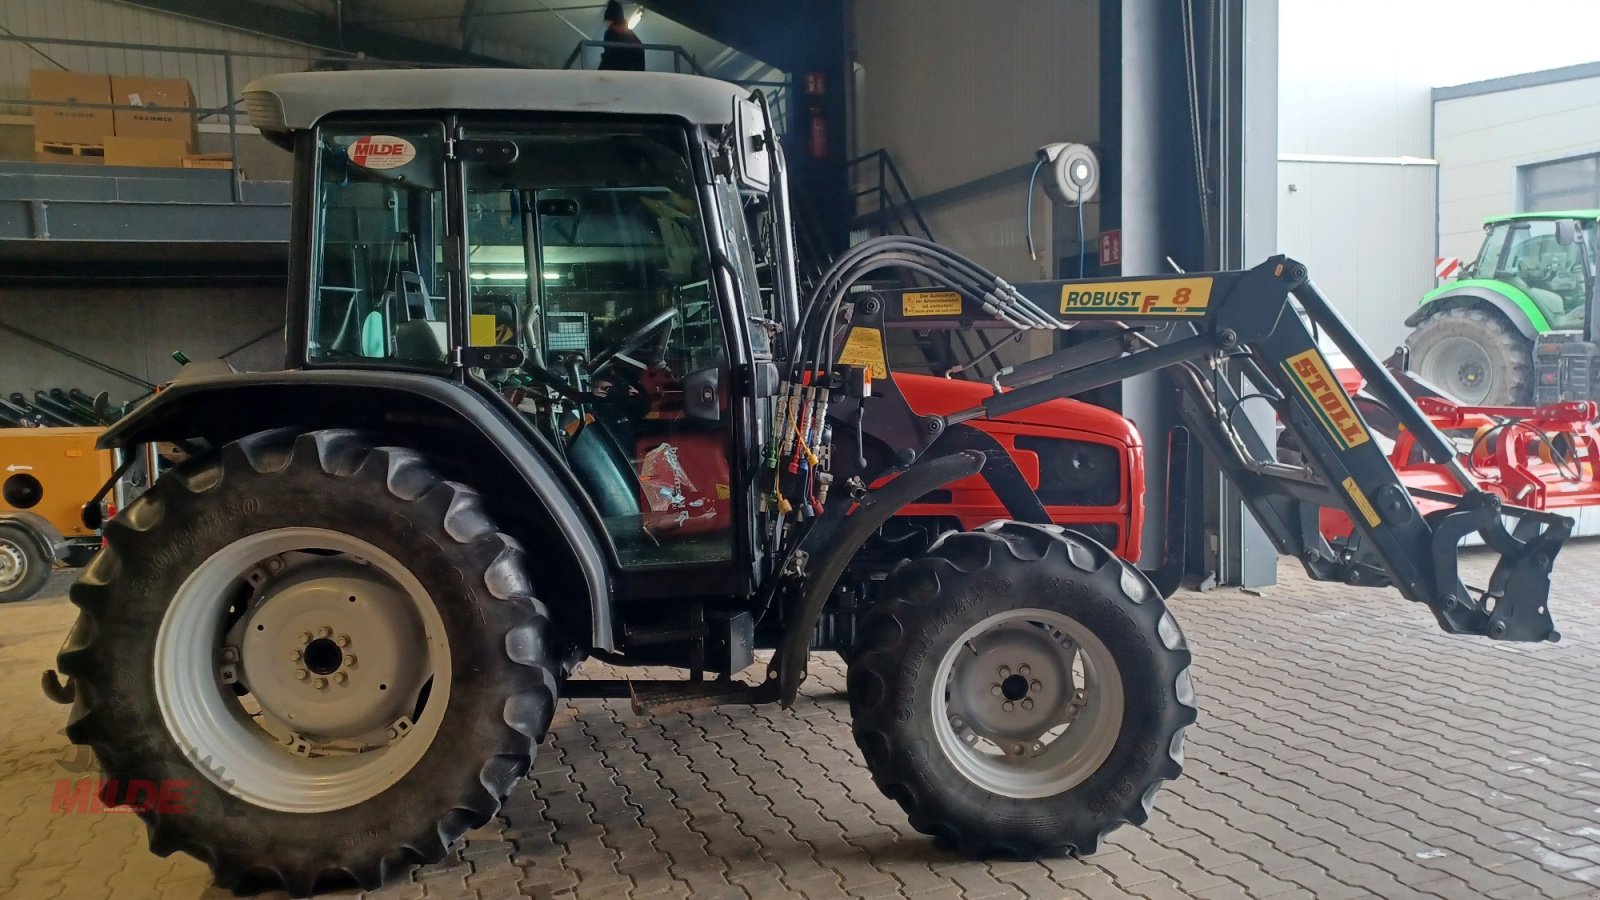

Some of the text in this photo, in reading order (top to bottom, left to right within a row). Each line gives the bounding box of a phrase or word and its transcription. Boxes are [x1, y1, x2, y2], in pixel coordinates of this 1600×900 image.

[354, 144, 404, 155] MILDE
[1066, 288, 1192, 314] ROBUST F 8
[1293, 357, 1362, 443] STOLL
